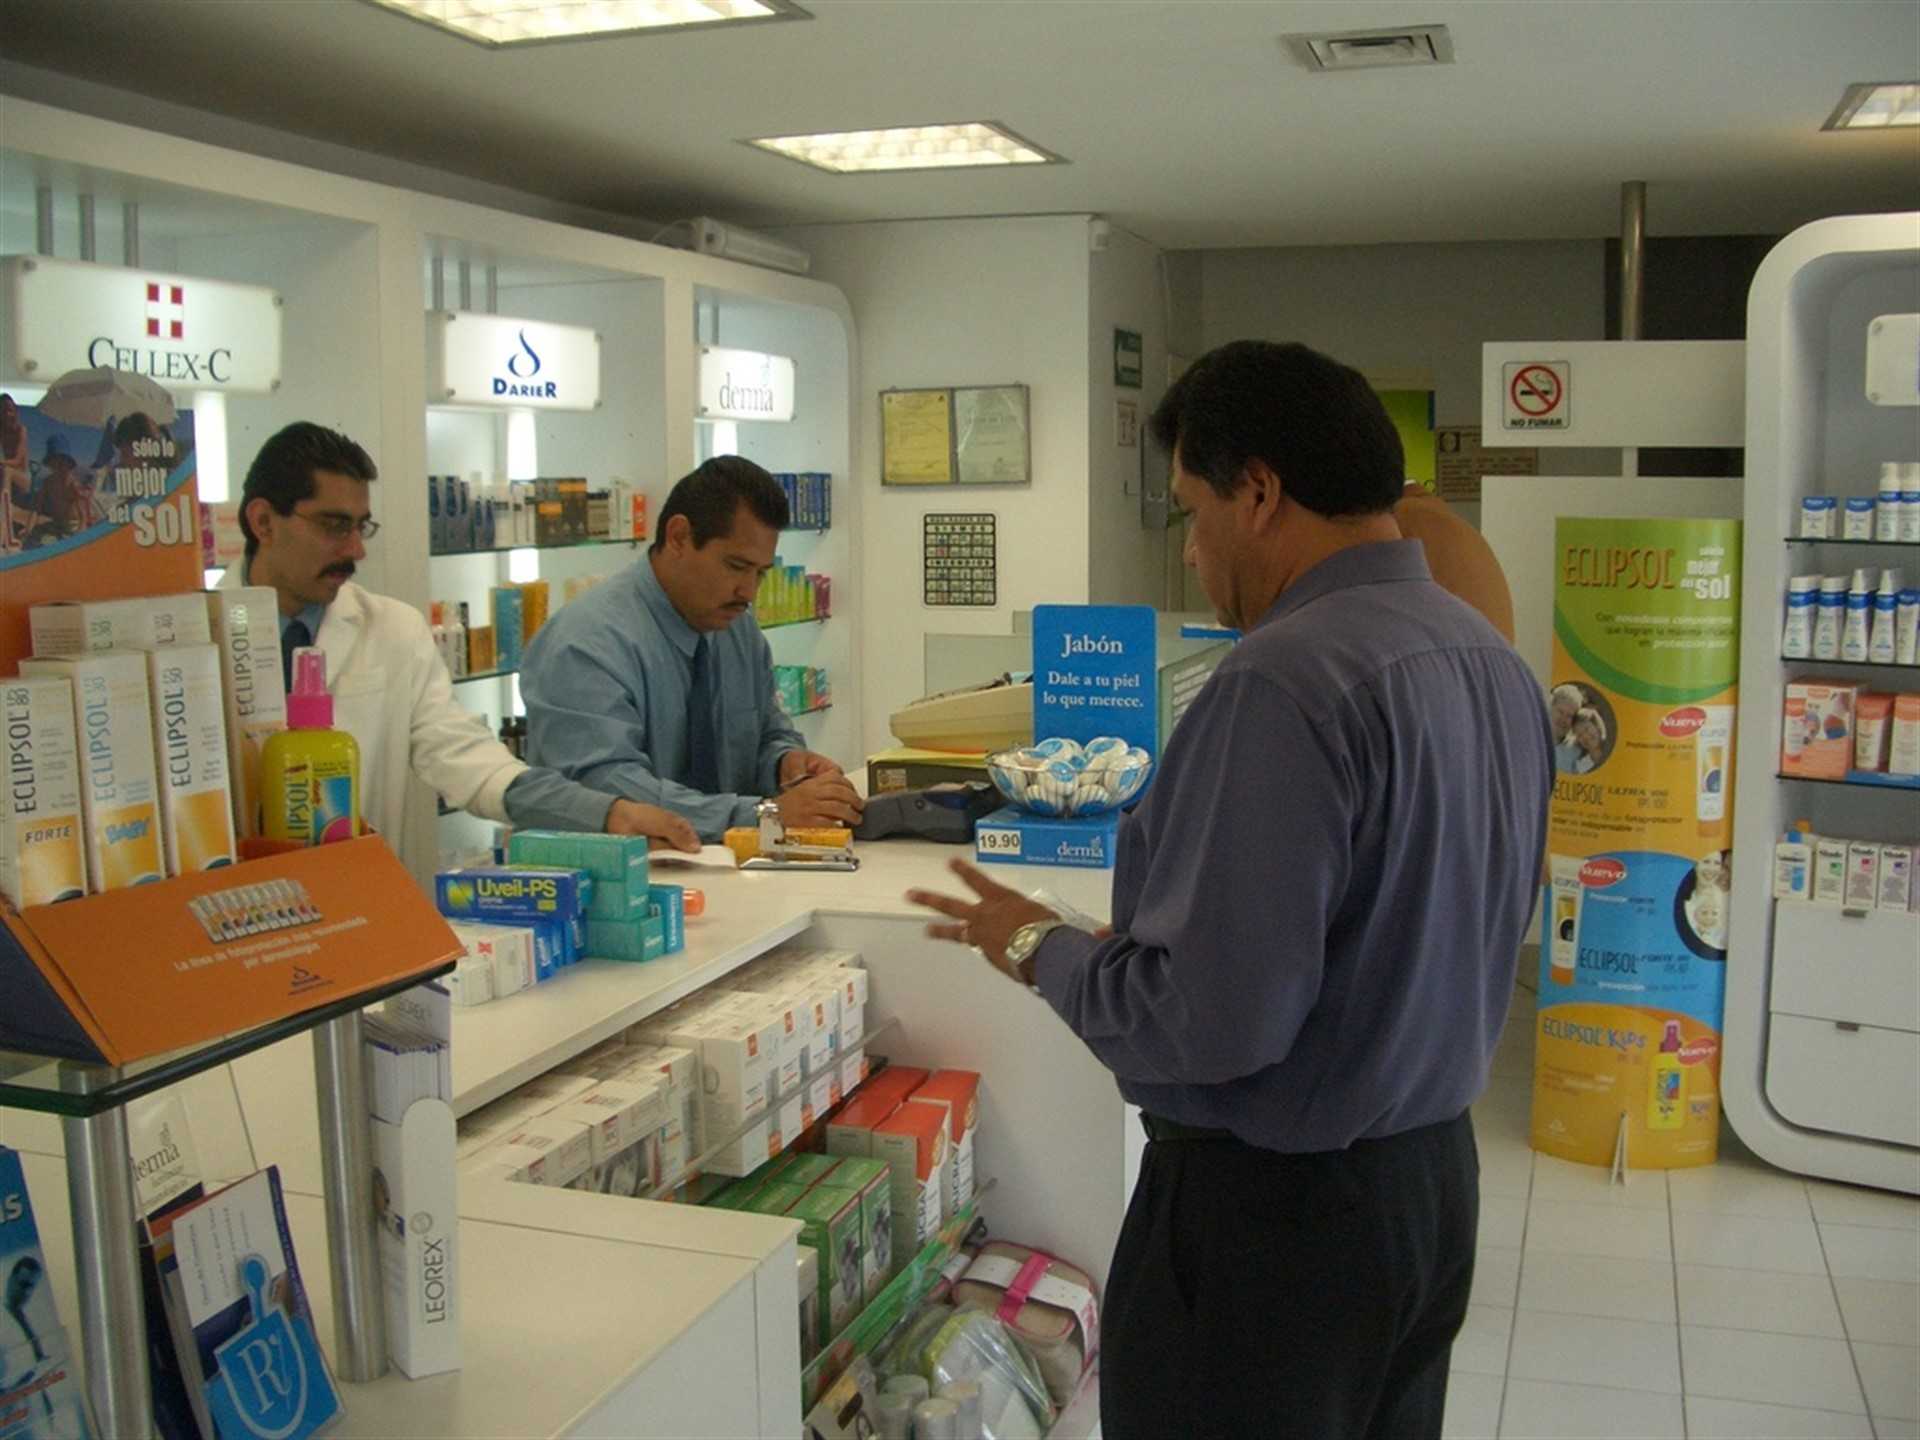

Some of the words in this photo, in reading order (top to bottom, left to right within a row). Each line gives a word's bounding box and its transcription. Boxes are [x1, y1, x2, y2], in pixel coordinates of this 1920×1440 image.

[88, 337, 232, 383] CELLEX-C
[1511, 418, 1525, 427] NO
[1528, 418, 1562, 427] FUMAR
[115, 462, 167, 498] mejor
[132, 495, 194, 546] sol
[1563, 545, 1676, 589] ECLIPSOL
[1695, 574, 1731, 599] sol
[1061, 633, 1124, 658] Jabón
[232, 626, 255, 717] ECLIPSOL
[1047, 671, 1080, 686] Dale
[1084, 675, 1092, 686] a
[1095, 673, 1110, 687] tu
[1113, 672, 1140, 690] piel
[1043, 691, 1057, 705] lo
[1060, 694, 1085, 709] que
[1089, 696, 1144, 708] merece.
[85, 699, 117, 802] ECLIPSOL
[163, 687, 192, 788] ECLIPSOL
[8, 709, 37, 814] ECLIPSOL
[287, 777, 311, 840] LIPSOL
[25, 825, 71, 844] FORTE
[980, 833, 1020, 849] 19.90
[1057, 840, 1104, 858] derma
[476, 877, 557, 899] Uveil-PS
[1579, 948, 1638, 975] ECLIPSOL
[1543, 1016, 1602, 1047] ECLIPSOL
[424, 1238, 446, 1325] LEOREX
